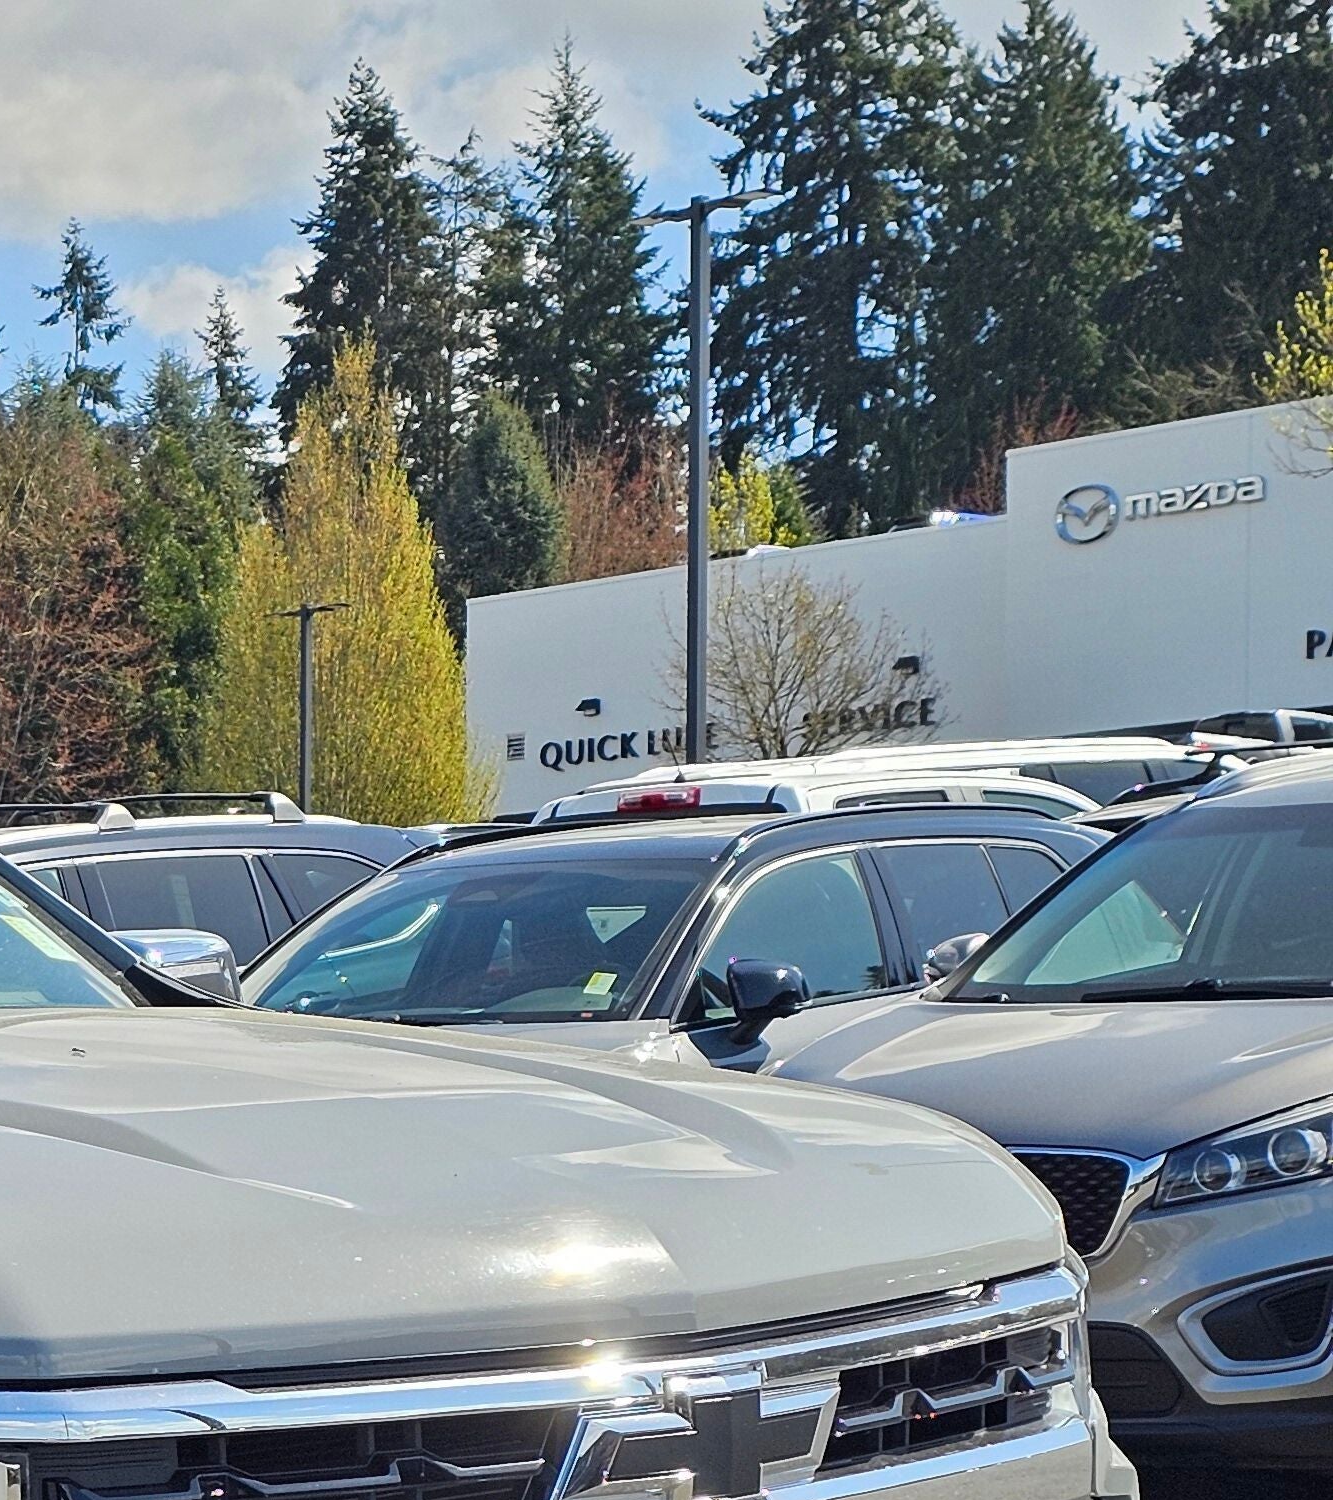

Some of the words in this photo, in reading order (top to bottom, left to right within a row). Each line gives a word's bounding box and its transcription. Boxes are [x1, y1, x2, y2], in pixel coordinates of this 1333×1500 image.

[1123, 474, 1267, 521] mazda
[1305, 629, 1333, 660] P
[802, 697, 936, 739] SRVICE
[540, 732, 640, 772] QUICK
[647, 722, 719, 756] LUE
